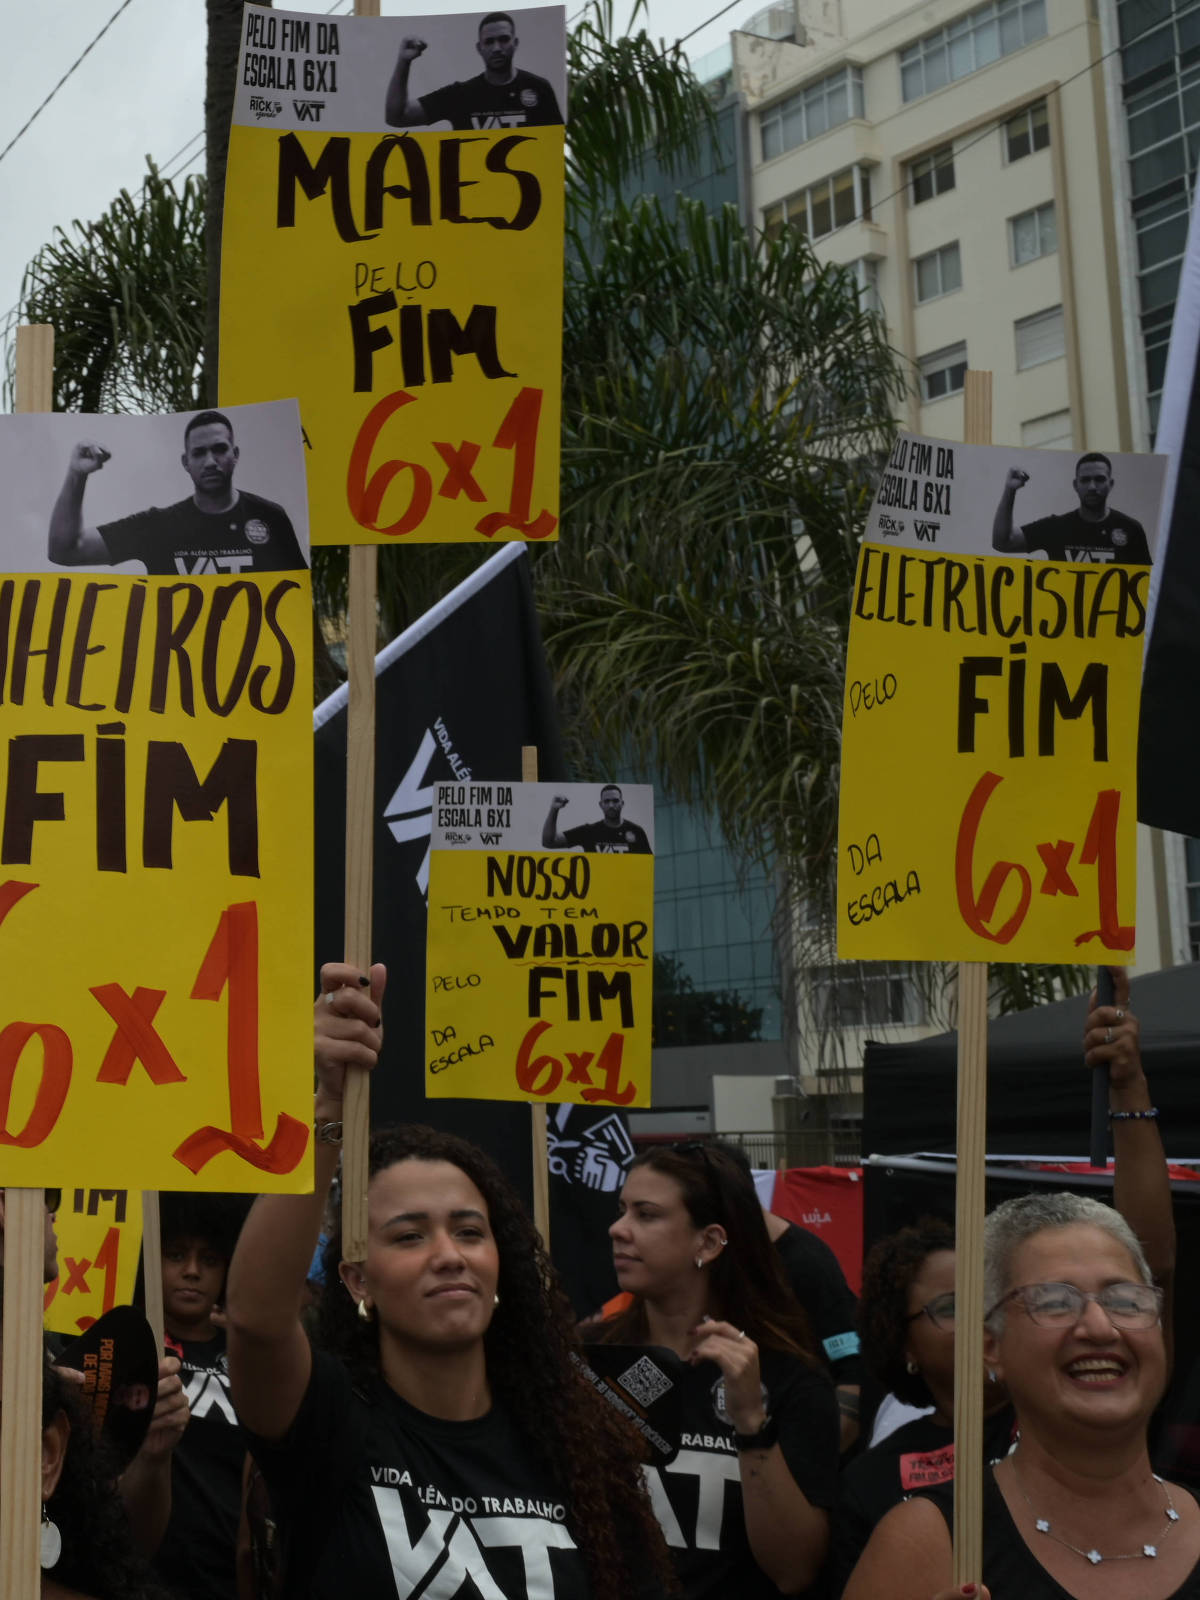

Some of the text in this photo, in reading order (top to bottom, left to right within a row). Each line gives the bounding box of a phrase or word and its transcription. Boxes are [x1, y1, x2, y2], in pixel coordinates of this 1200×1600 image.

[246, 13, 340, 55] PELO FIM DA
[244, 52, 337, 92] ESCALA 6X1
[250, 100, 272, 112] RICK
[355, 261, 437, 297] PELO
[348, 290, 518, 393] FIM
[909, 442, 932, 476] FIM
[936, 447, 954, 480] DA
[923, 481, 951, 515] 6X1
[854, 548, 1147, 639] ELETRICISTAS
[849, 672, 898, 718] PELO
[957, 641, 1109, 763] FIM
[0, 721, 261, 879] FIM
[438, 786, 513, 806] PELO FIM DA
[438, 808, 511, 828] ESCALA 6X1
[847, 833, 883, 876] DA
[486, 855, 591, 900] NOSSO
[847, 870, 922, 926] ESCALA
[540, 907, 599, 919] TEM
[493, 921, 649, 959] VALOR
[432, 974, 481, 992] PELO
[529, 960, 634, 1028] FIM
[429, 1034, 494, 1074] ESCALA
[431, 1026, 456, 1046] DA
[370, 1466, 413, 1487] VIDA
[452, 1497, 478, 1514] DO
[482, 1496, 566, 1521] TRABALHO
[370, 1485, 578, 1600] VAT
